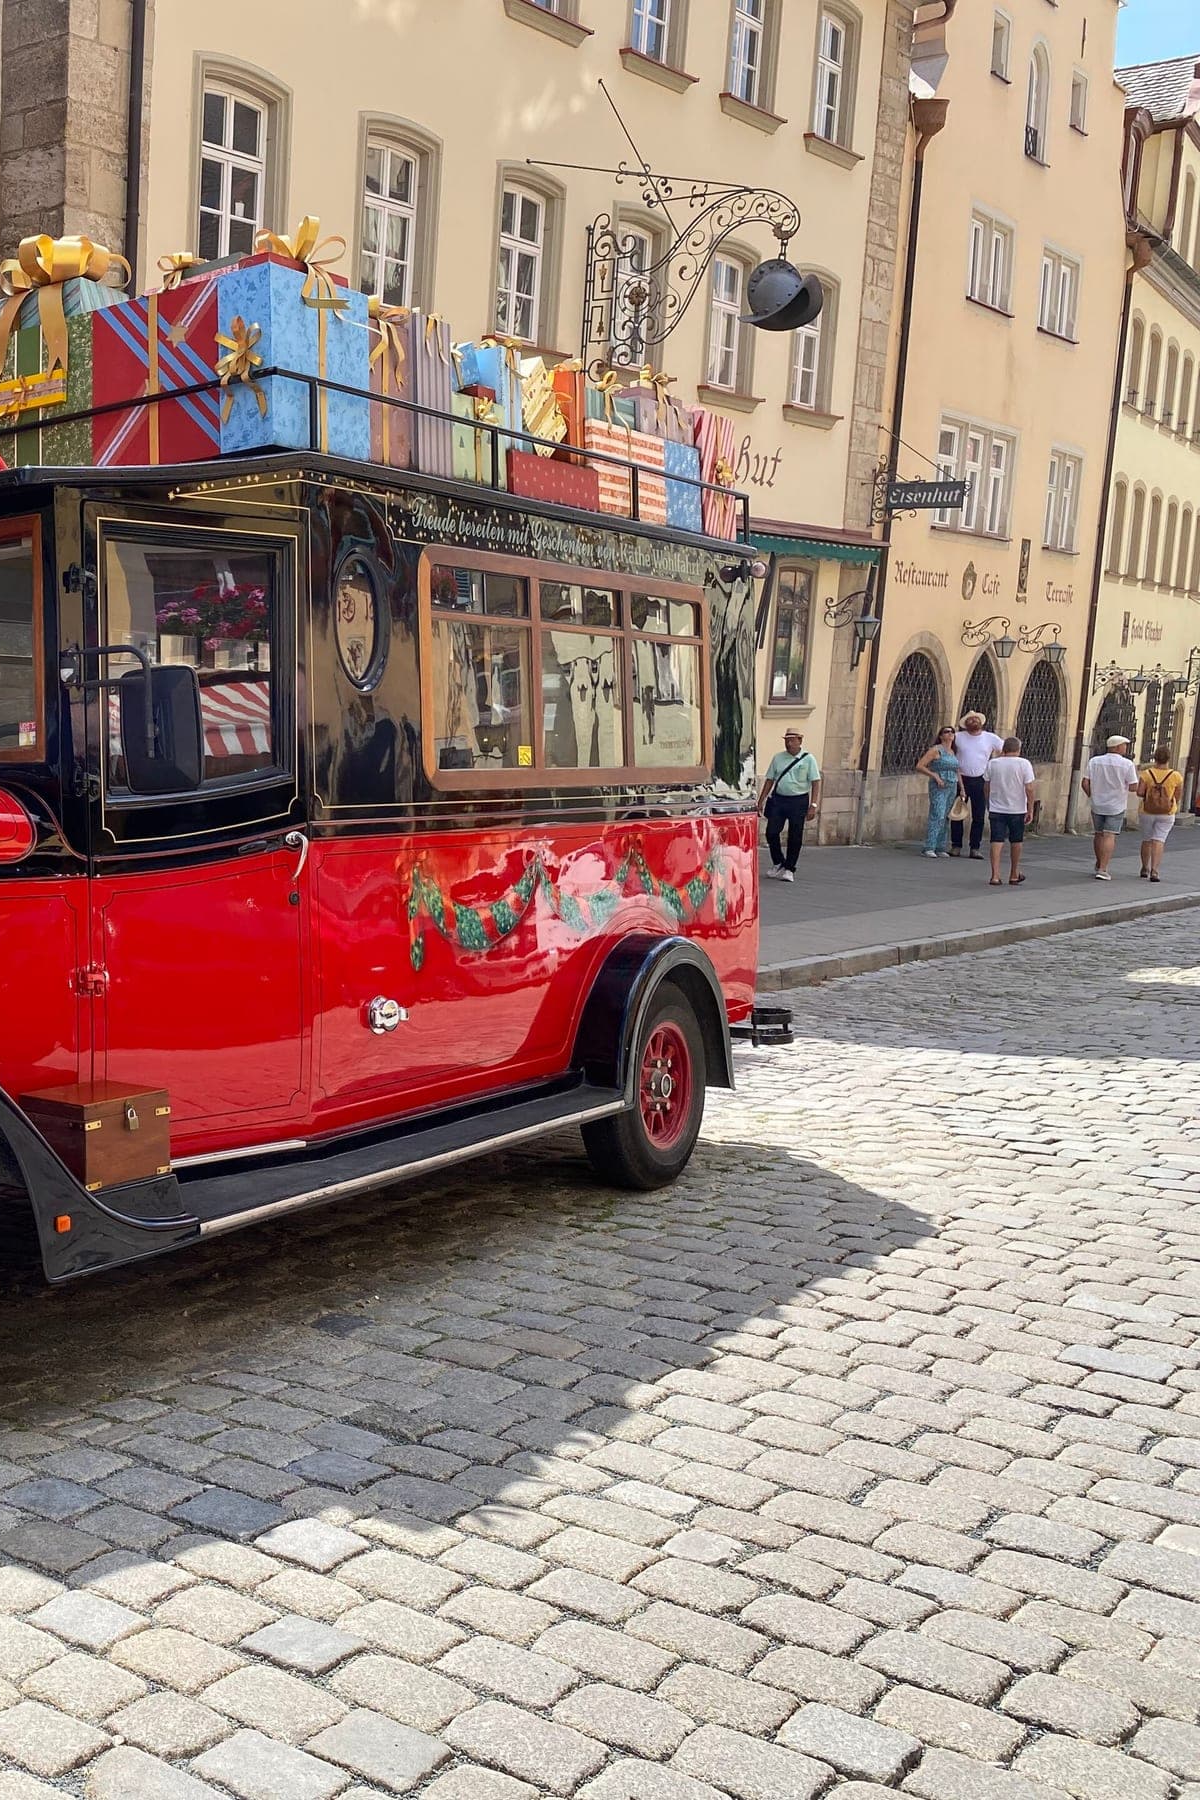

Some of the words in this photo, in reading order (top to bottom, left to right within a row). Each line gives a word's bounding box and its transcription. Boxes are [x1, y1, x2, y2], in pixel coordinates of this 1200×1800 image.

[889, 487, 961, 504] Eisenhut
[411, 497, 456, 533] Freude
[458, 511, 505, 541] bereiten
[508, 523, 530, 546] mit
[531, 519, 594, 558] Geschenken
[597, 545, 615, 562] von
[620, 542, 650, 567] Käthe
[652, 547, 701, 575] Wohlfahrt
